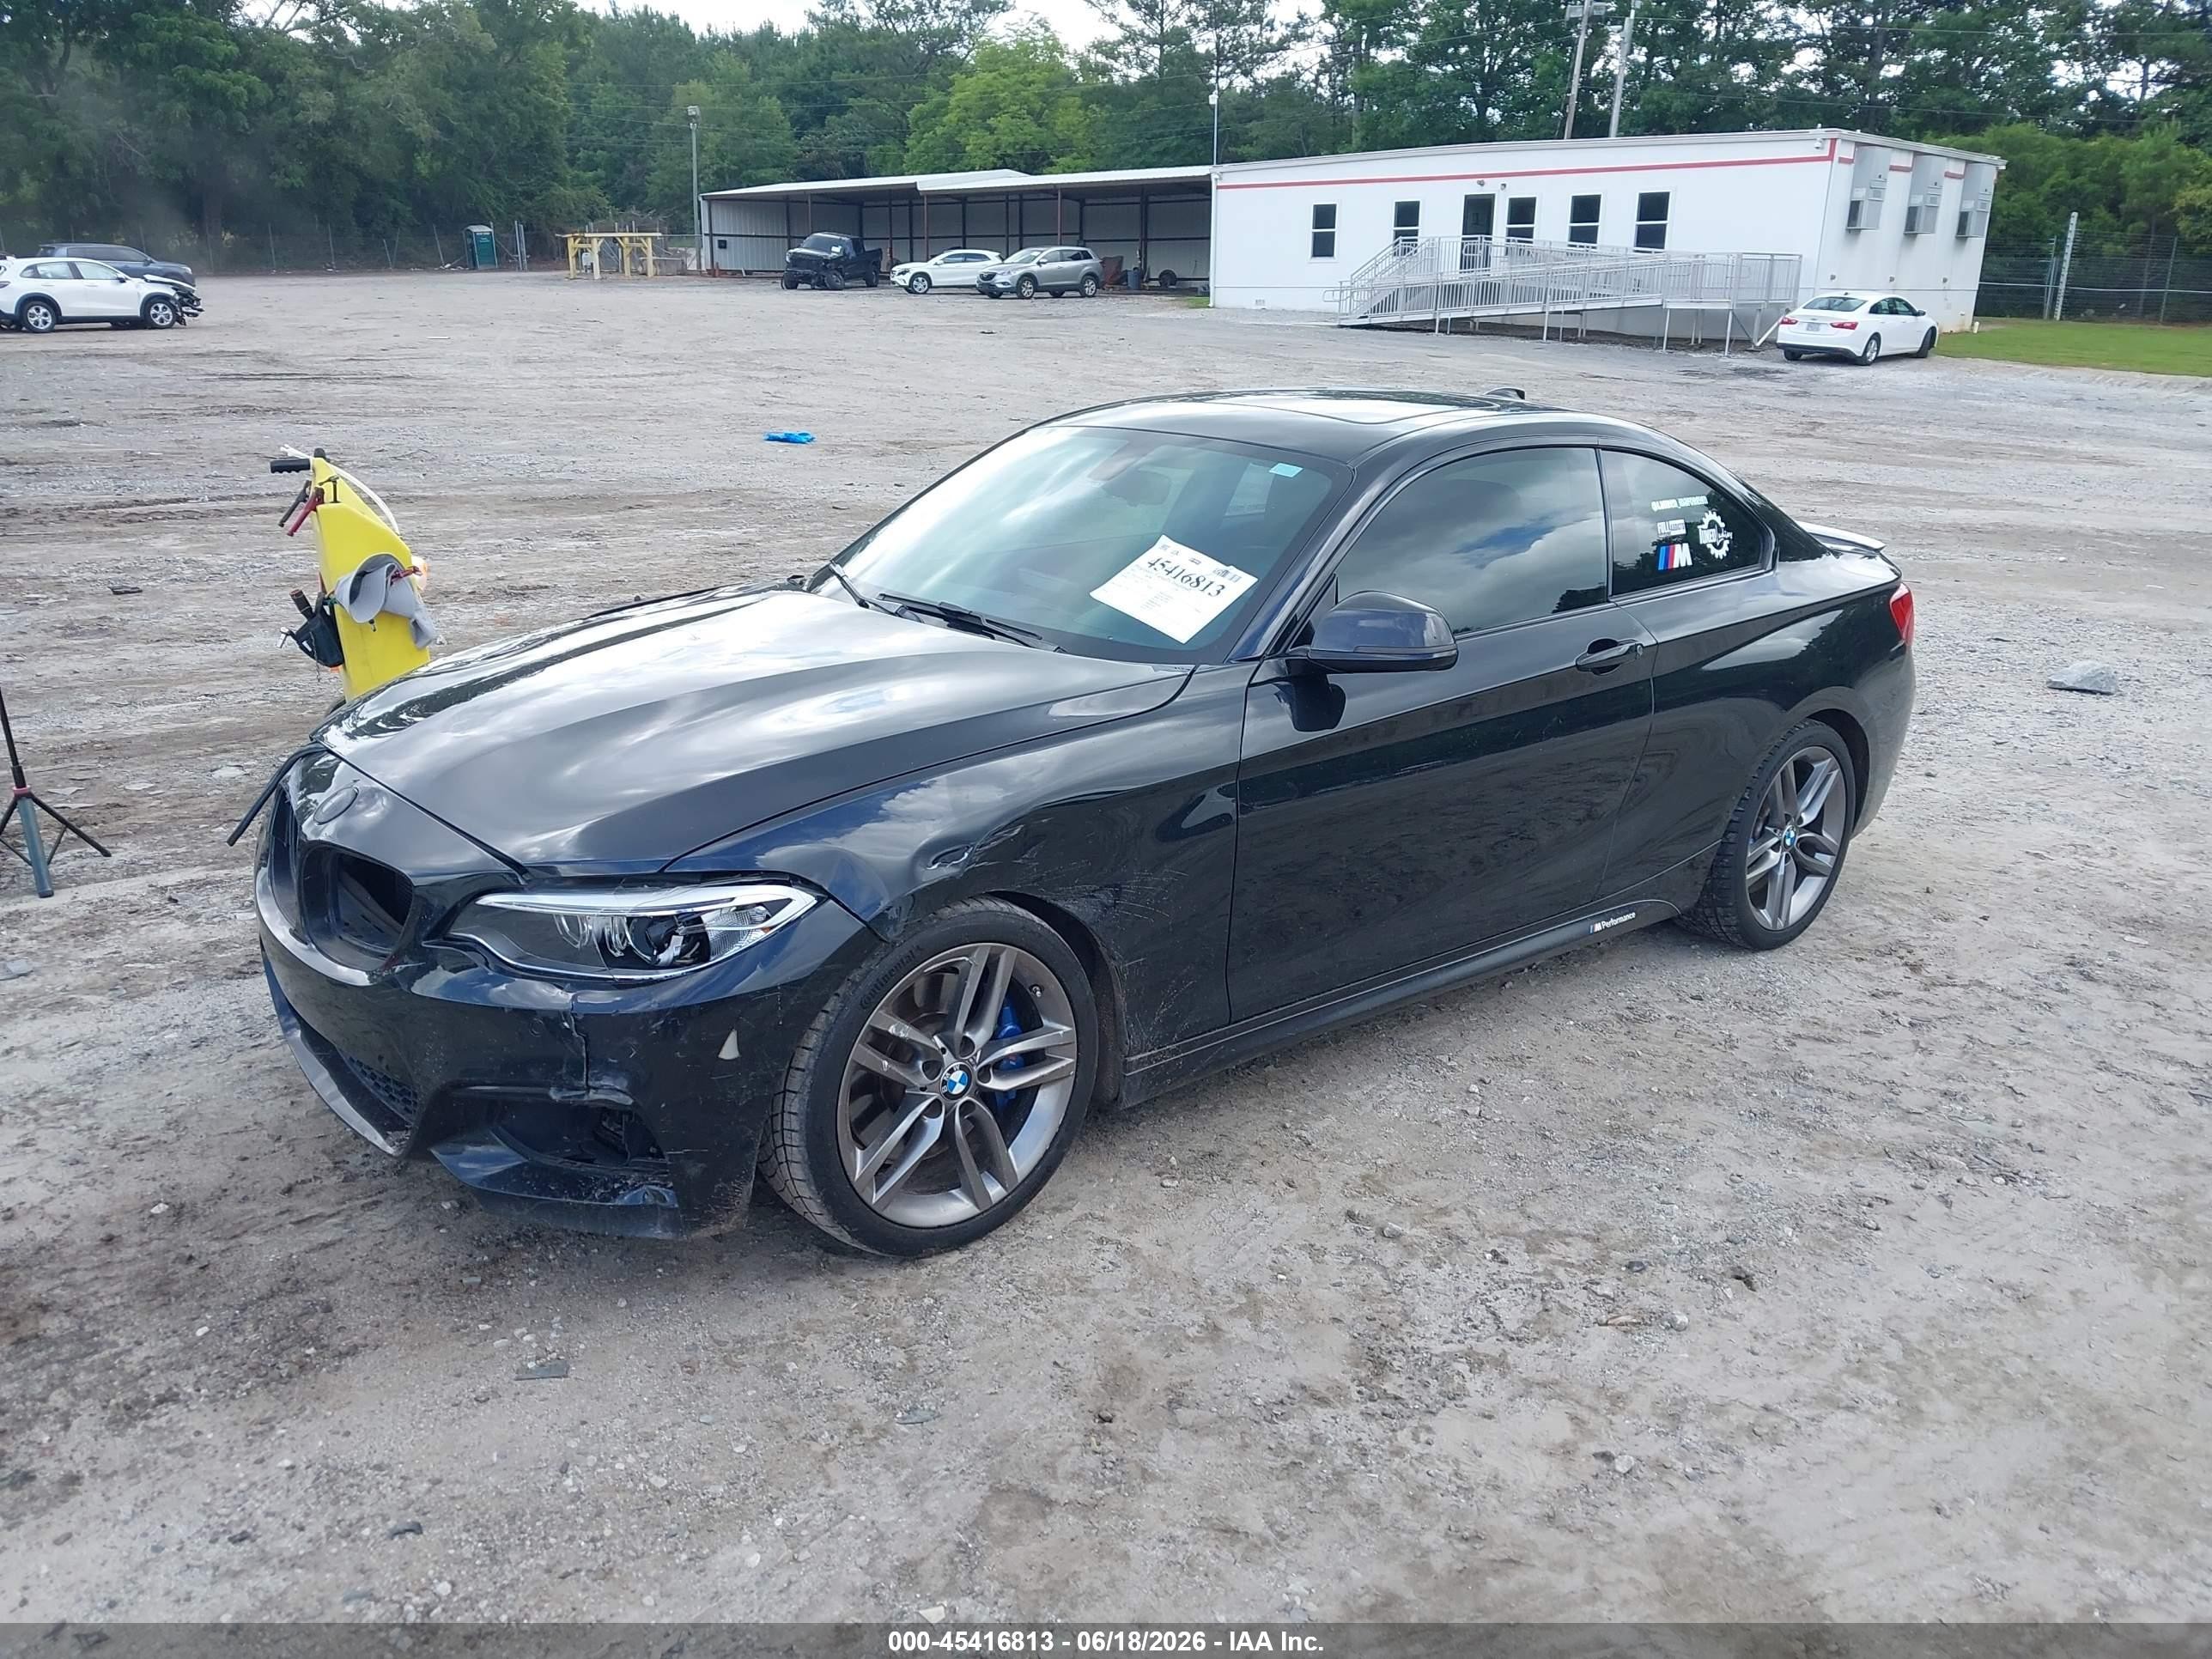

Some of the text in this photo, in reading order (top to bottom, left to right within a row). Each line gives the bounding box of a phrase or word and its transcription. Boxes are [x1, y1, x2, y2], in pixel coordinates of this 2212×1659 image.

[1672, 543, 1692, 568] M
[1147, 556, 1226, 598] 45416813
[1601, 912, 1636, 929] Performance
[859, 949, 917, 1010] Continental
